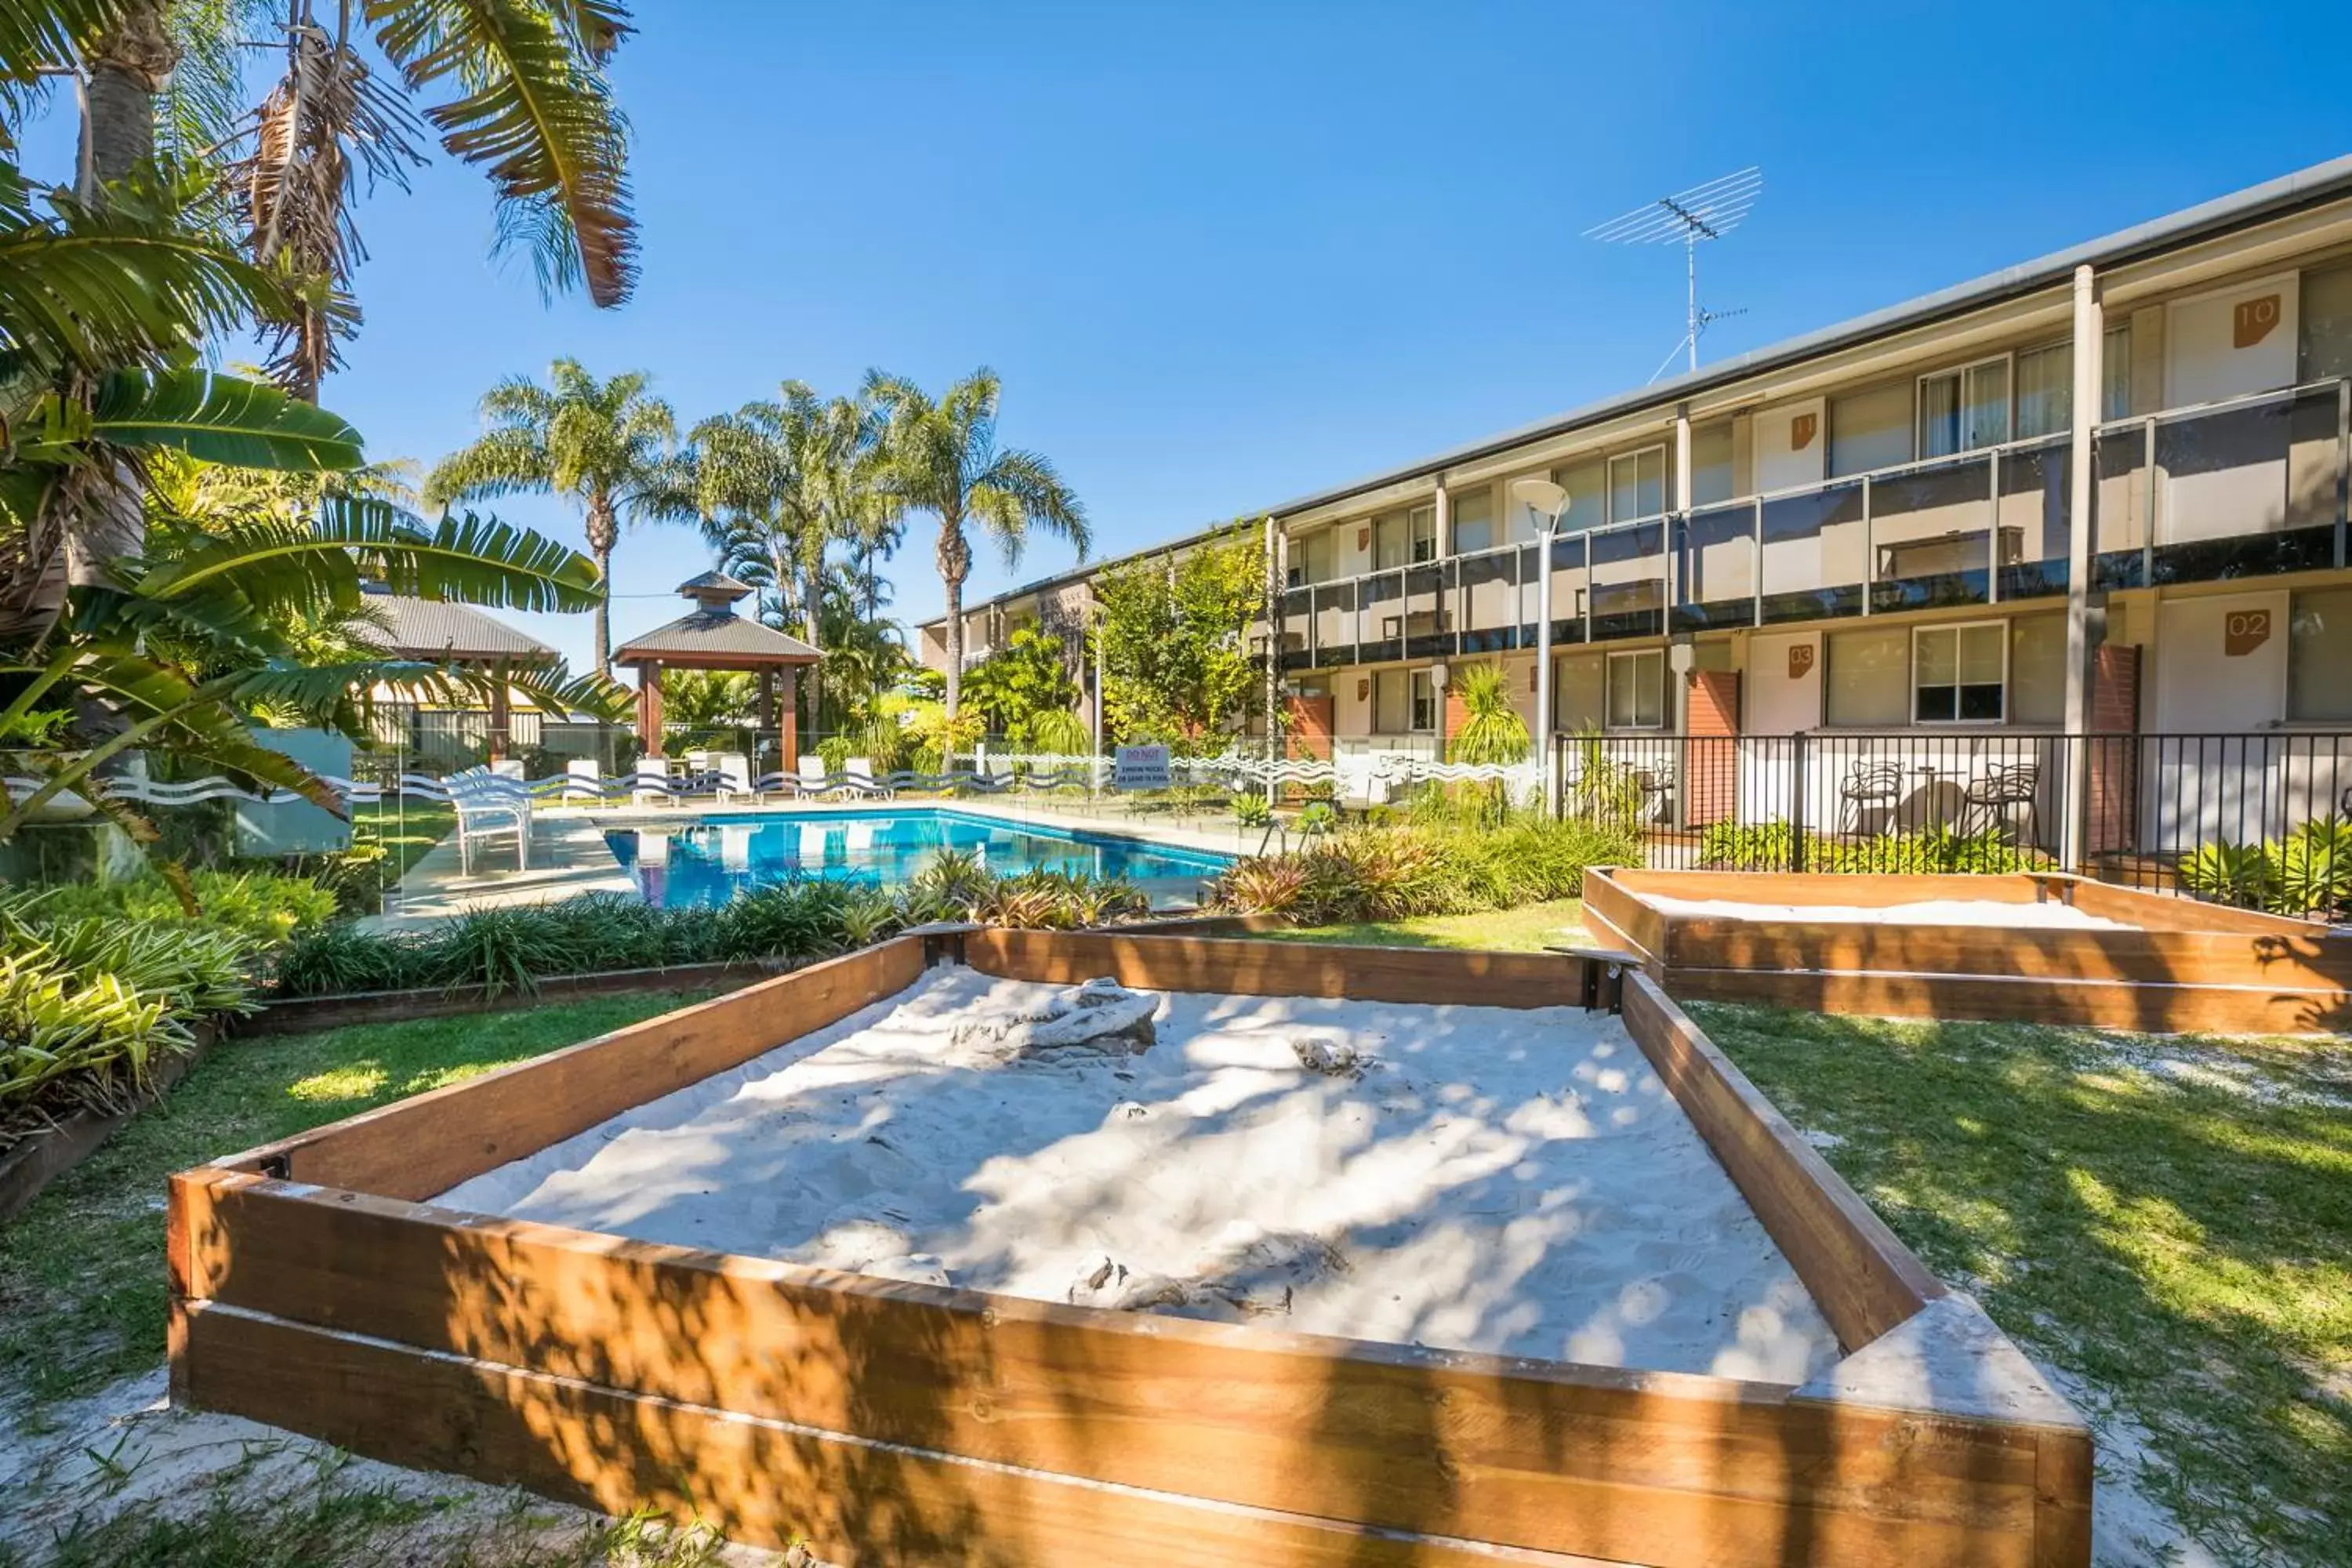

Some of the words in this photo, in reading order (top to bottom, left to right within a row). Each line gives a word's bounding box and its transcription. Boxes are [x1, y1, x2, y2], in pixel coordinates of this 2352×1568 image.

[2242, 301, 2274, 326] 10
[2230, 614, 2267, 636] 02
[1791, 648, 1812, 664] 03
